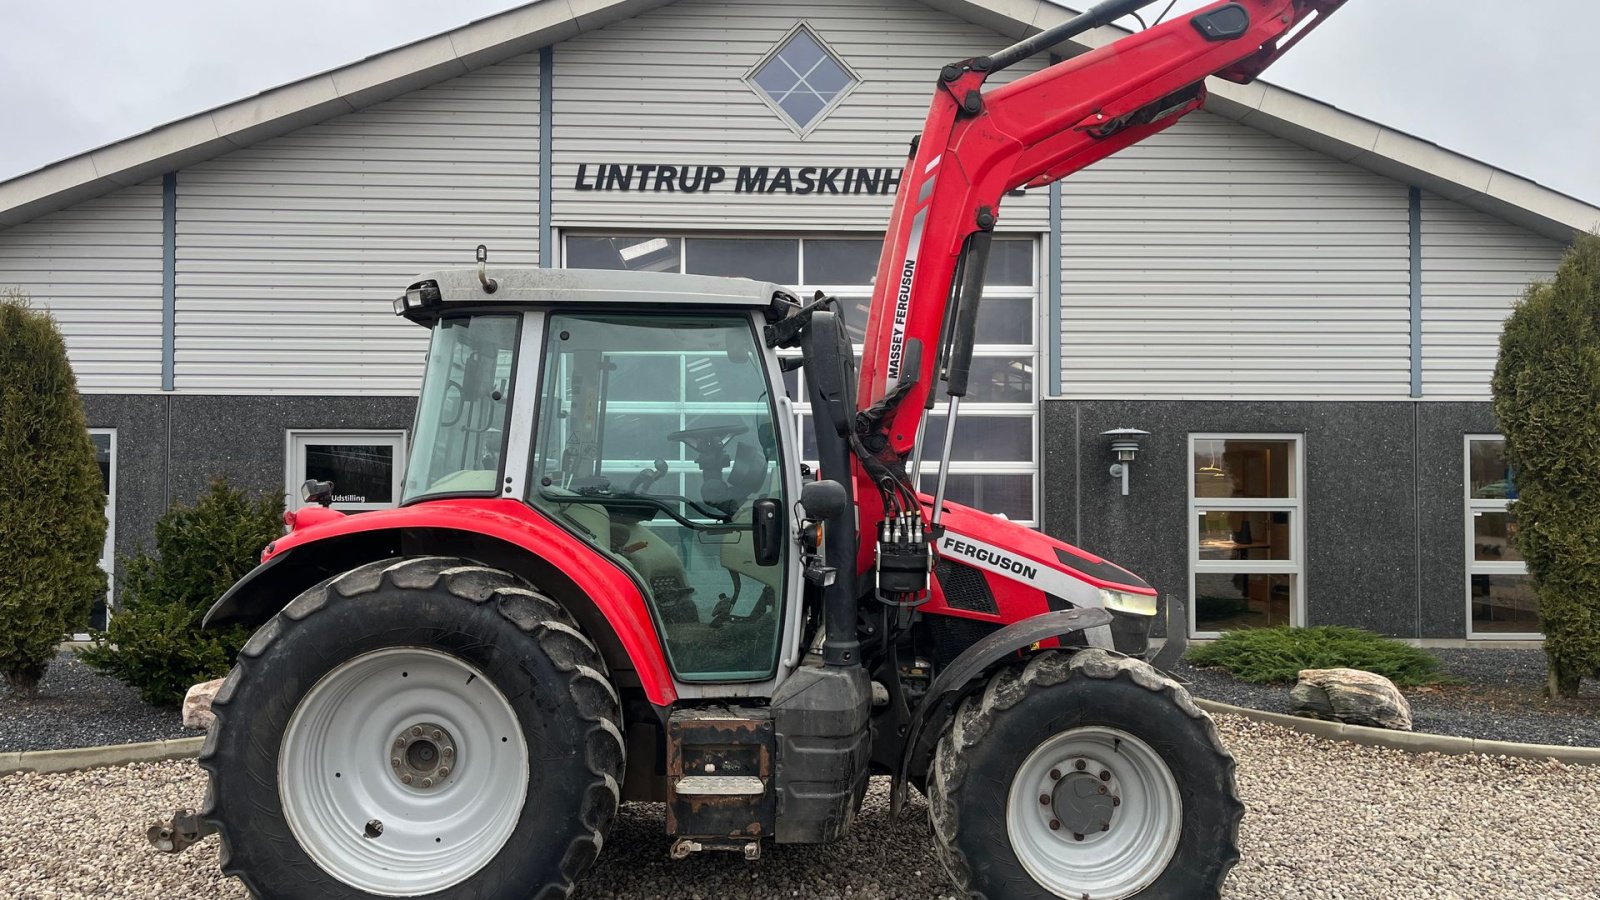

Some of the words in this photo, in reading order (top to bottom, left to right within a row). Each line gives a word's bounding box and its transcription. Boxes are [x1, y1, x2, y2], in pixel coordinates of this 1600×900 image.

[574, 163, 726, 193] LINTRUP
[734, 167, 1026, 196] MASKINH
[895, 259, 915, 325] FERGUSON
[888, 327, 904, 379] MASSEY
[331, 495, 366, 503] Udstilling
[944, 537, 1038, 580] FERGUSON
